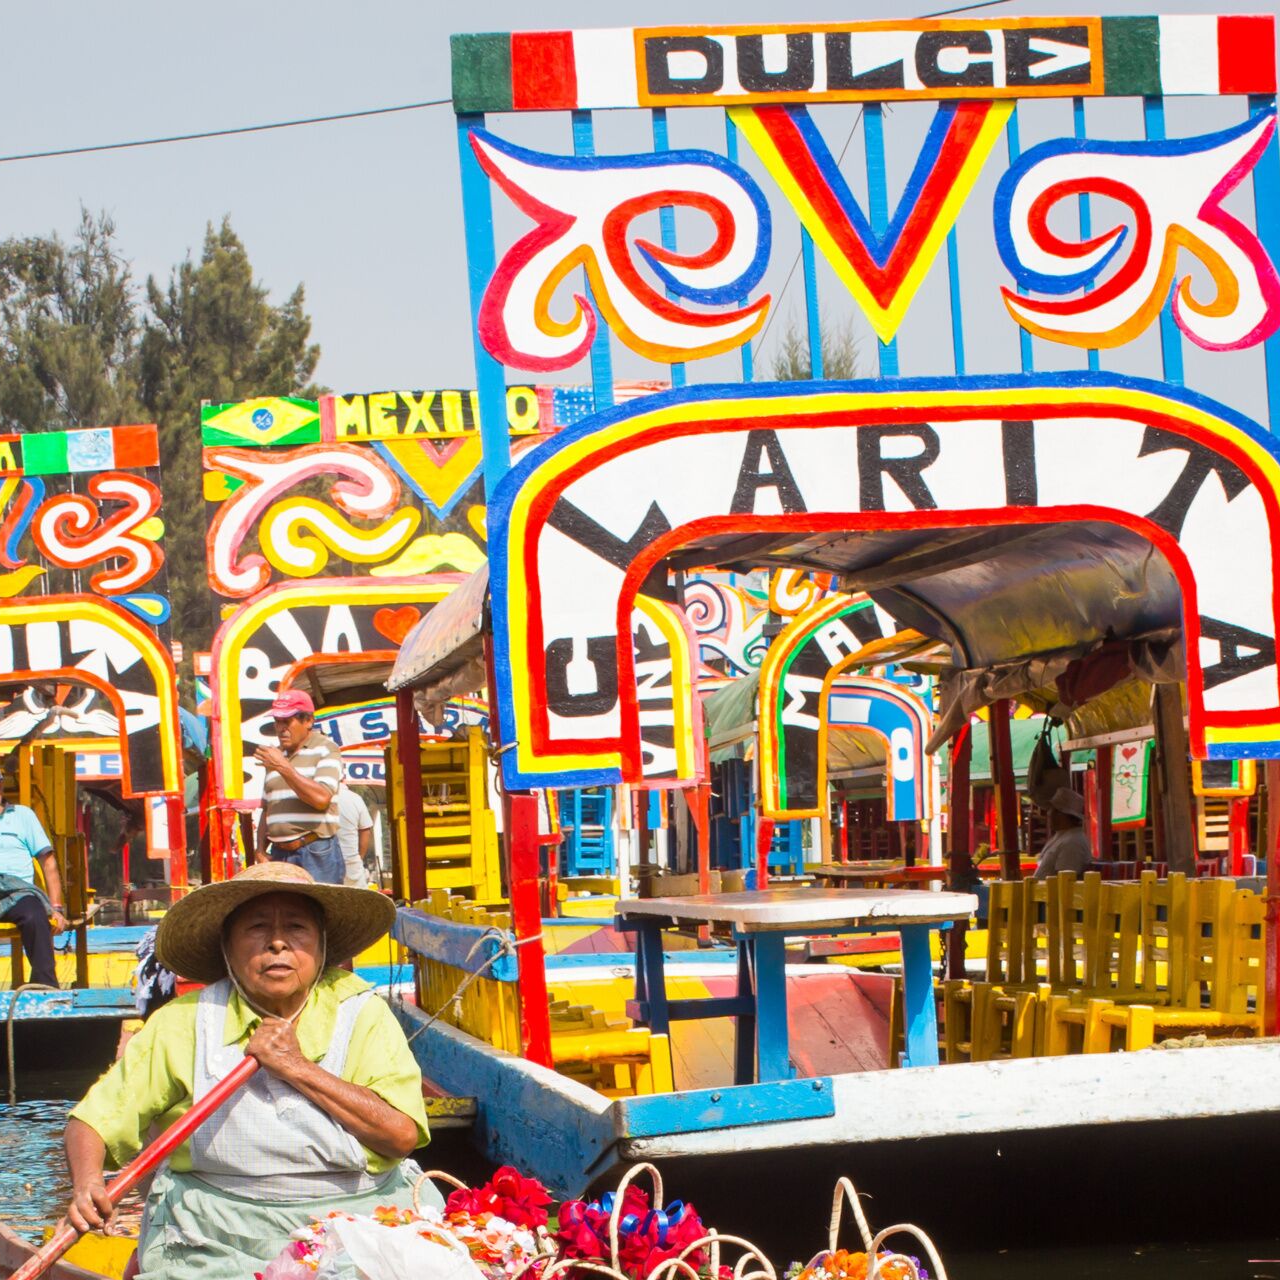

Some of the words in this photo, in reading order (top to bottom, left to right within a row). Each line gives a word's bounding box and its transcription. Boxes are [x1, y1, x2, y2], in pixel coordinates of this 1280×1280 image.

[643, 25, 1091, 95] DULCE
[335, 386, 540, 437] MEXIO
[545, 419, 1279, 717] CLARITA
